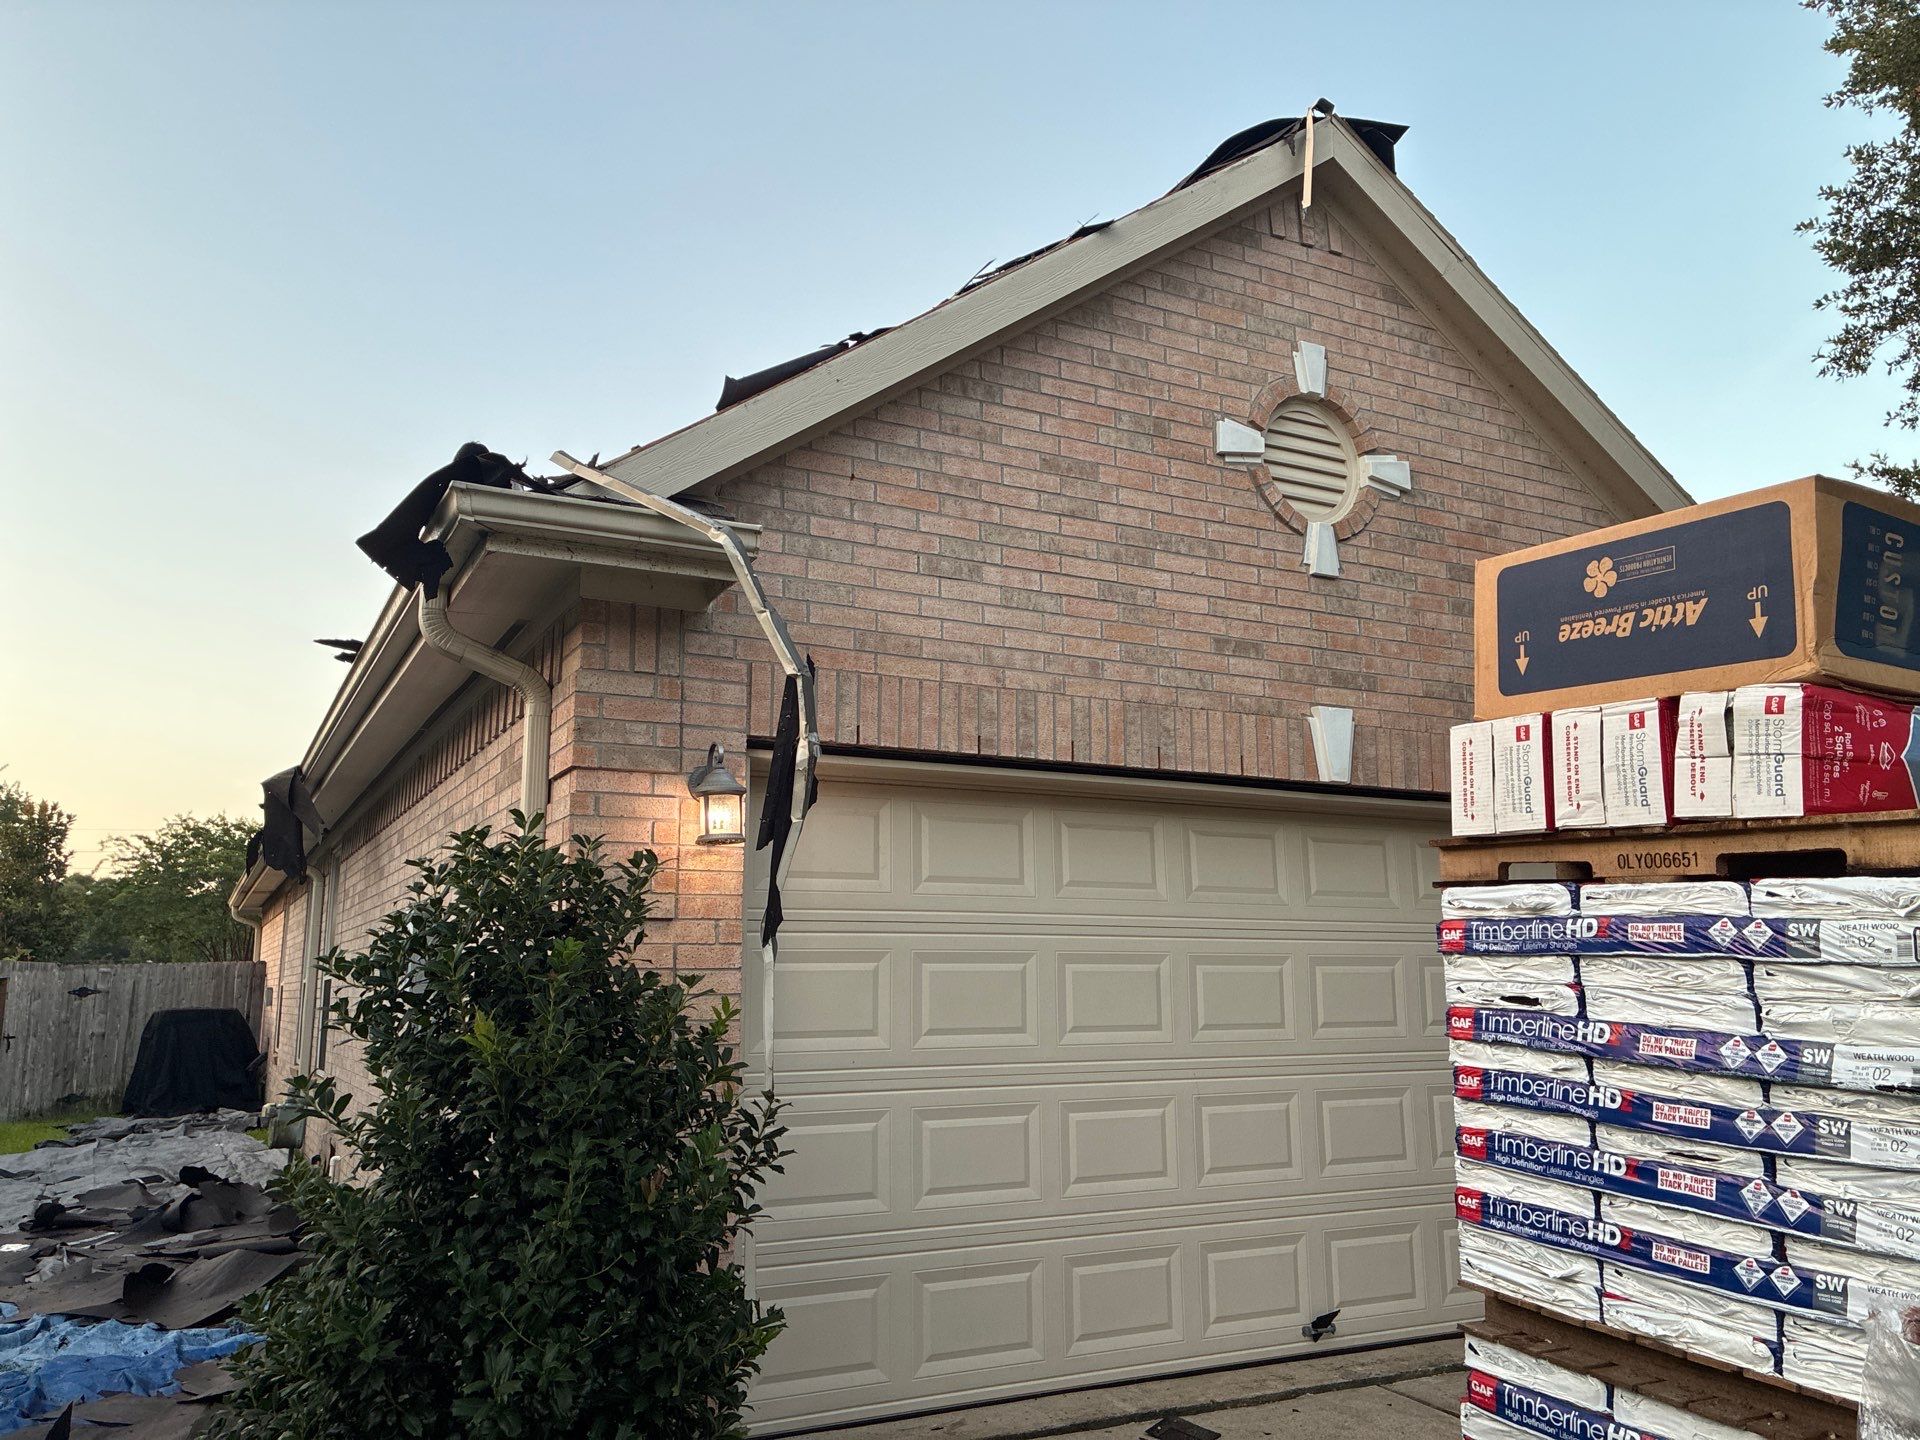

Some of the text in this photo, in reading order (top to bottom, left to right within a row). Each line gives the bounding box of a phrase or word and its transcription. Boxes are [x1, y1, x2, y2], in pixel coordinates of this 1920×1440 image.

[1619, 562, 1643, 573] PRODUCTS
[1671, 589, 1706, 599] America's
[1746, 584, 1768, 600] UP
[1622, 602, 1640, 611] Solar
[1648, 596, 1671, 605] Leader
[1560, 612, 1593, 622] Ventilation
[1594, 606, 1621, 617] Powered
[1558, 597, 1709, 643] Attic Breeze
[1514, 630, 1530, 643] UP
[1771, 696, 1779, 713] GAF
[1823, 701, 1833, 720] (200
[1823, 722, 1831, 735] sq.
[1825, 737, 1834, 749] ft.)
[1844, 733, 1853, 750] Roll
[1773, 718, 1786, 797] StormGuard
[1574, 764, 1579, 776] ON
[1636, 732, 1650, 807] StormGuard
[1469, 778, 1474, 789] ON
[1522, 744, 1533, 813] StormGuard
[1822, 772, 1830, 785] sq.
[1823, 788, 1831, 802] m.)
[1788, 922, 1818, 937] SW
[1871, 922, 1899, 930] WOOD
[1442, 929, 1463, 940] GAF
[1630, 932, 1682, 941] STACK PALLETS
[1472, 943, 1489, 951] High
[1857, 936, 1876, 948] 02
[1451, 1017, 1473, 1028] GAF
[1481, 1033, 1496, 1041] High
[1654, 1036, 1668, 1045] NOT
[1670, 1038, 1694, 1047] TRIPLE
[1641, 1044, 1693, 1057] STACK PALLETS
[1802, 1048, 1831, 1064] SW
[1853, 1052, 1915, 1063] WEATH WOOD
[1458, 1074, 1481, 1087] GAF
[1872, 1067, 1891, 1081] 02
[1490, 1092, 1506, 1101] High
[1655, 1104, 1708, 1117] DO NOT TRIPLE
[1654, 1111, 1708, 1127] STACK PALLETS
[1818, 1118, 1848, 1136] SW
[1462, 1133, 1485, 1148] GAF
[1890, 1139, 1908, 1152] 02
[1495, 1153, 1511, 1165] High
[1574, 1171, 1604, 1185] Shingles
[1660, 1170, 1714, 1187] DO NOT TRIPLE
[1660, 1178, 1714, 1198] STACK PALLETS
[1458, 1194, 1481, 1209] GAF
[1823, 1199, 1855, 1218] SW
[1489, 1217, 1506, 1230] High
[1896, 1226, 1915, 1243] 02
[1655, 1244, 1709, 1264] DO NOT TRIPLE
[1654, 1252, 1708, 1272] STACK PALLETS
[1815, 1274, 1846, 1293] SW
[1867, 1285, 1898, 1298] WEATH
[1471, 1380, 1494, 1397] GAF
[1505, 1407, 1522, 1422] High
[1522, 1411, 1556, 1434] Definition
